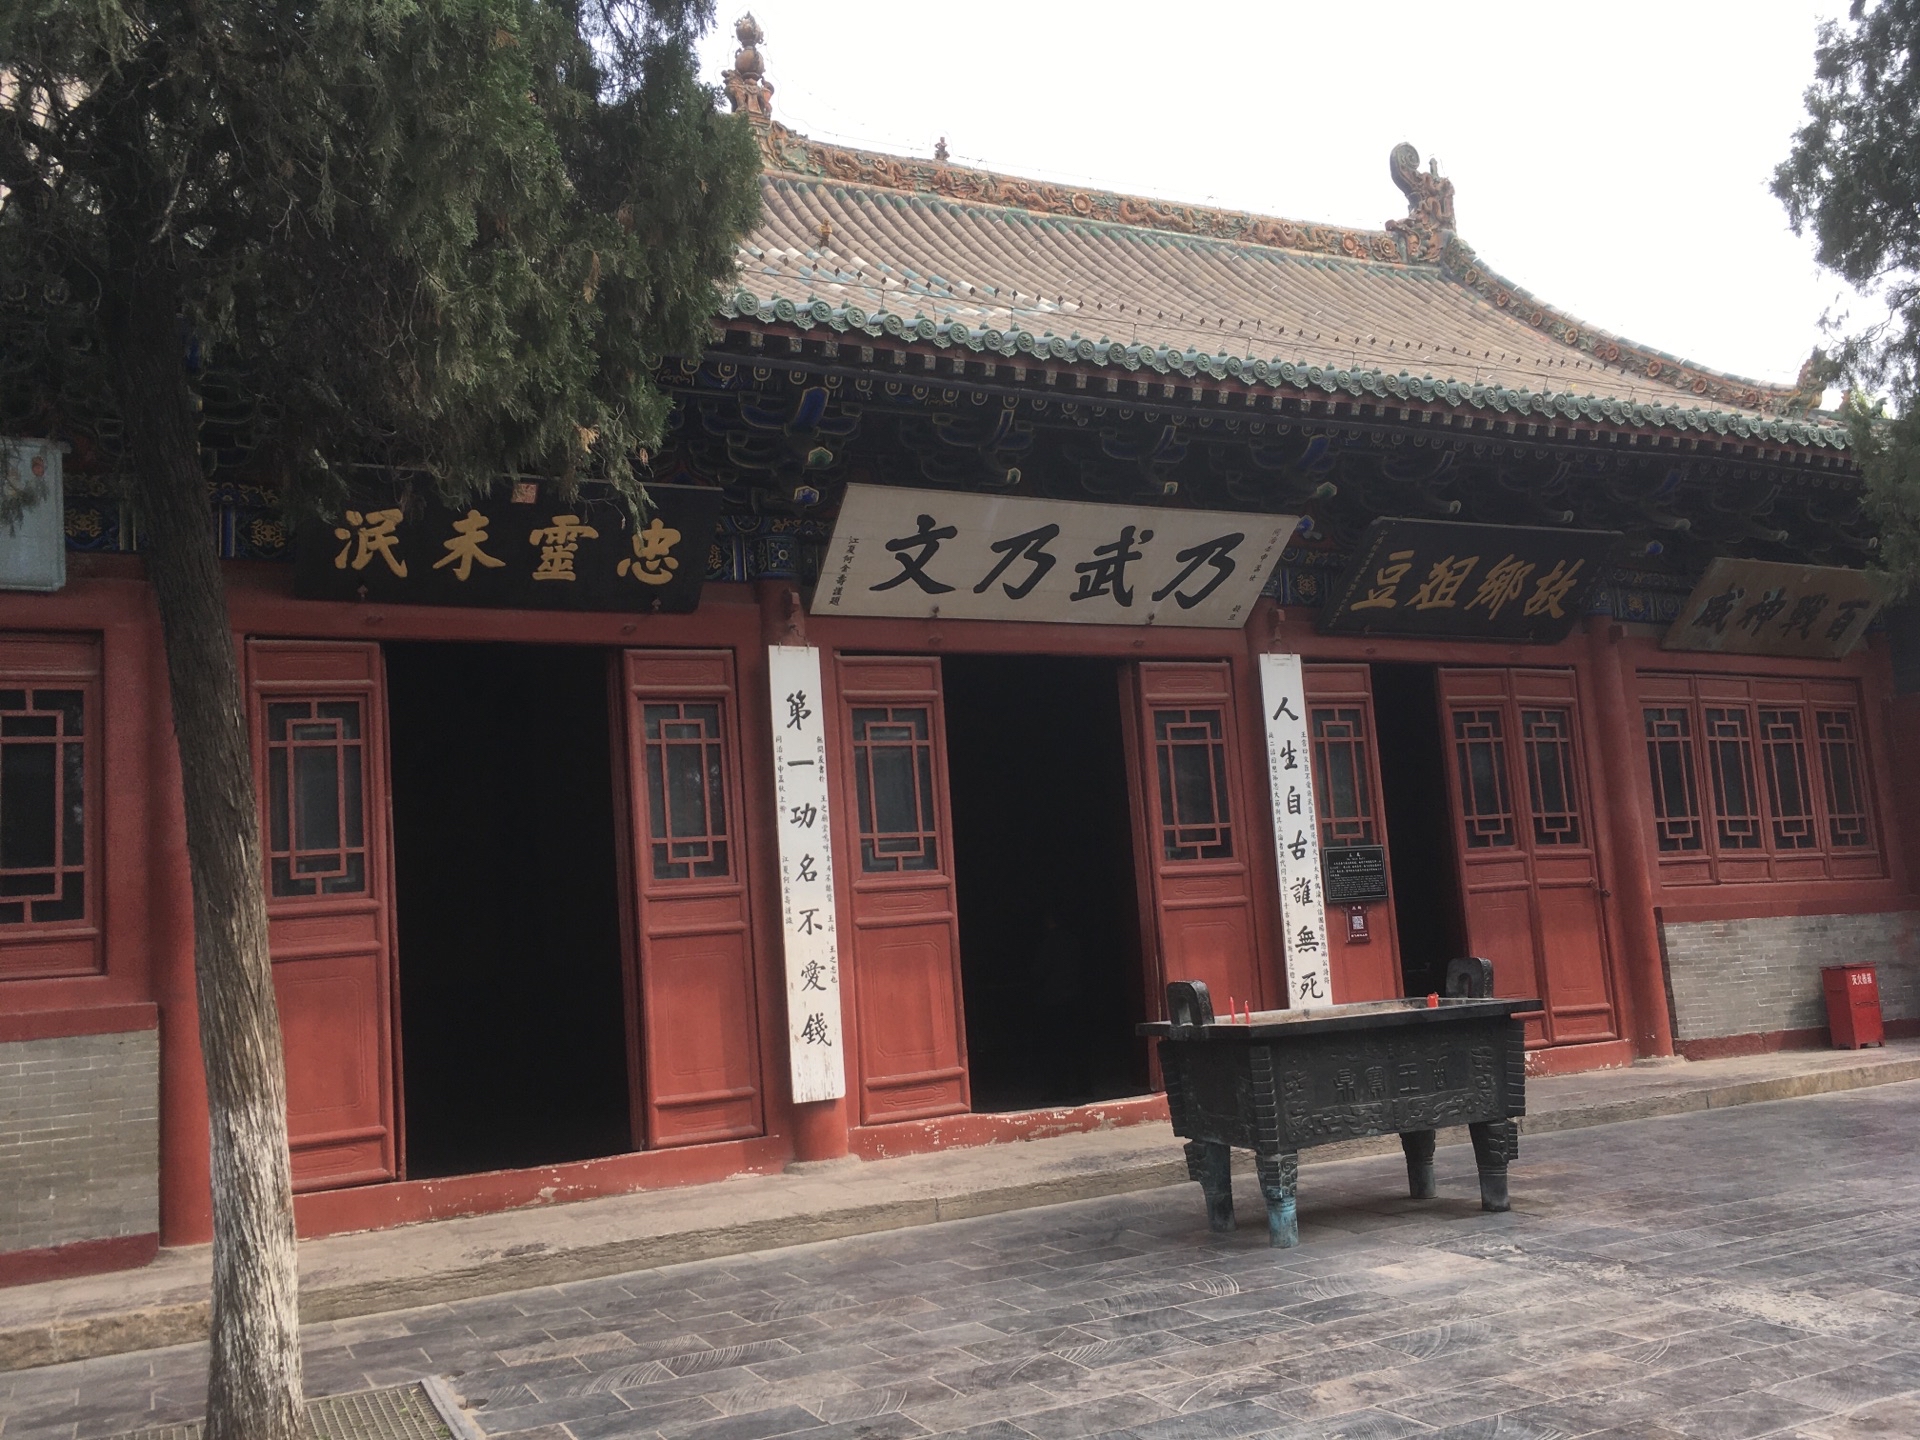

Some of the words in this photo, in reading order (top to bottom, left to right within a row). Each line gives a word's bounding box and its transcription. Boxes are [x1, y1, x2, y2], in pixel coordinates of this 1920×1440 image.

[786, 690, 832, 1047] 第一功名不愛錢
[1272, 697, 1323, 999] 人生自古誰無死
